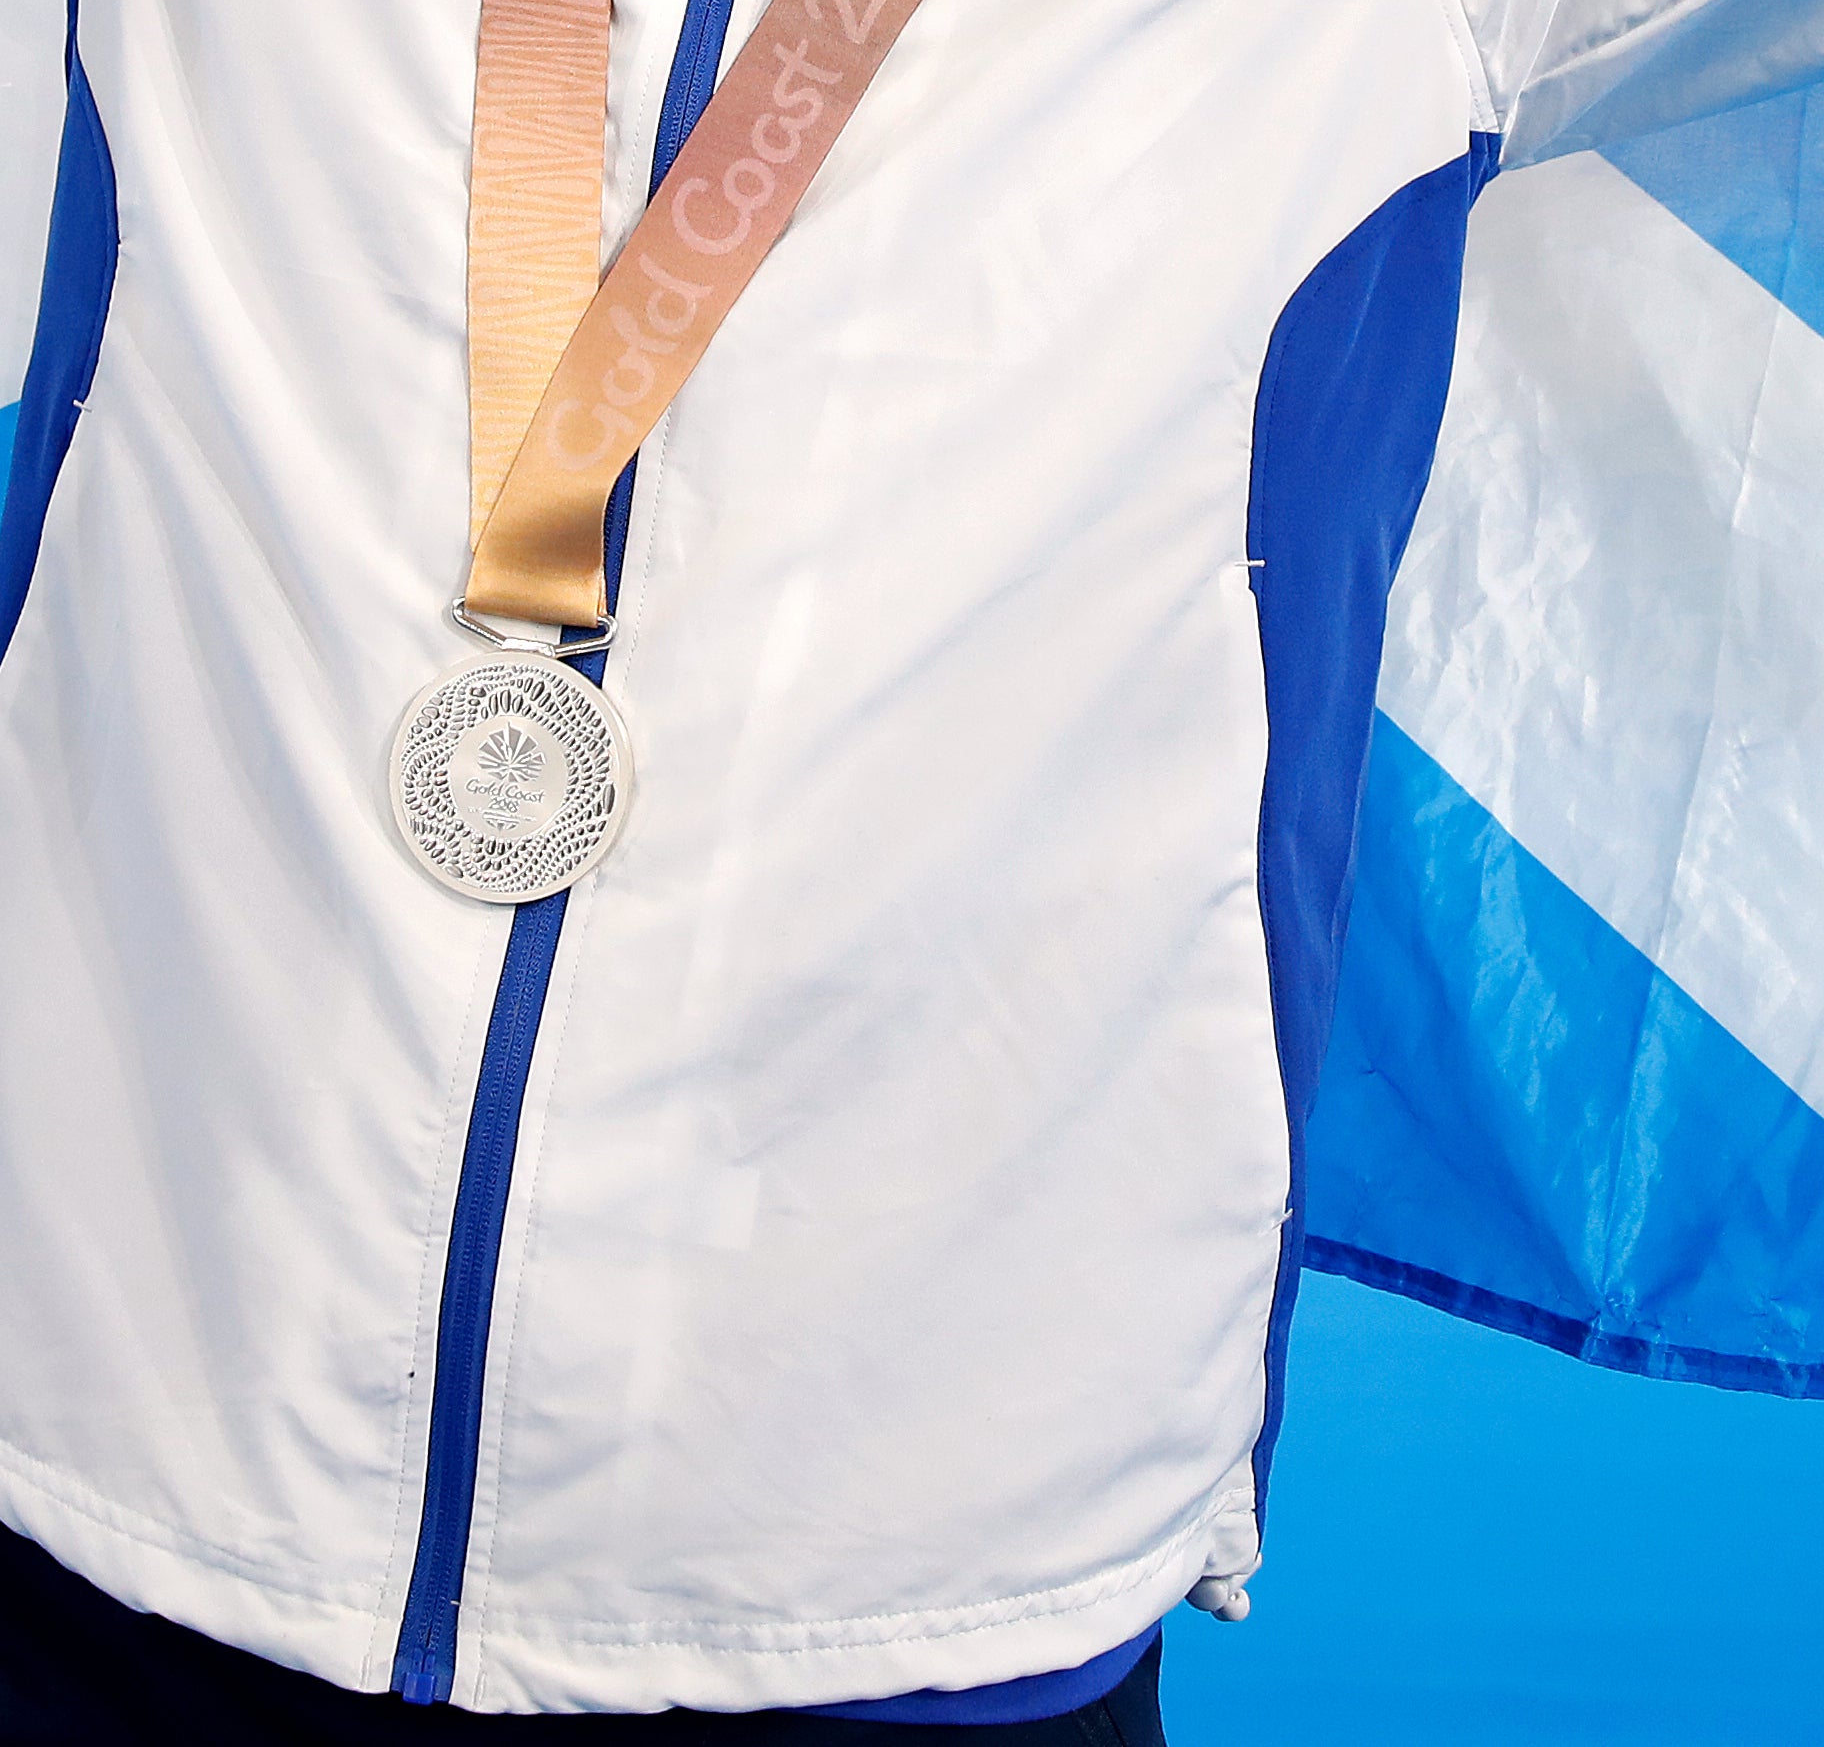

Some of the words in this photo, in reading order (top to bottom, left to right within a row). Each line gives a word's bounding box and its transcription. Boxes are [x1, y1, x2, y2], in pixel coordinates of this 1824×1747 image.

[545, 254, 713, 472] Gold
[670, 38, 844, 256] Coast
[464, 777, 504, 797] Gold
[505, 784, 545, 803] Coast
[487, 797, 519, 814] 2018
